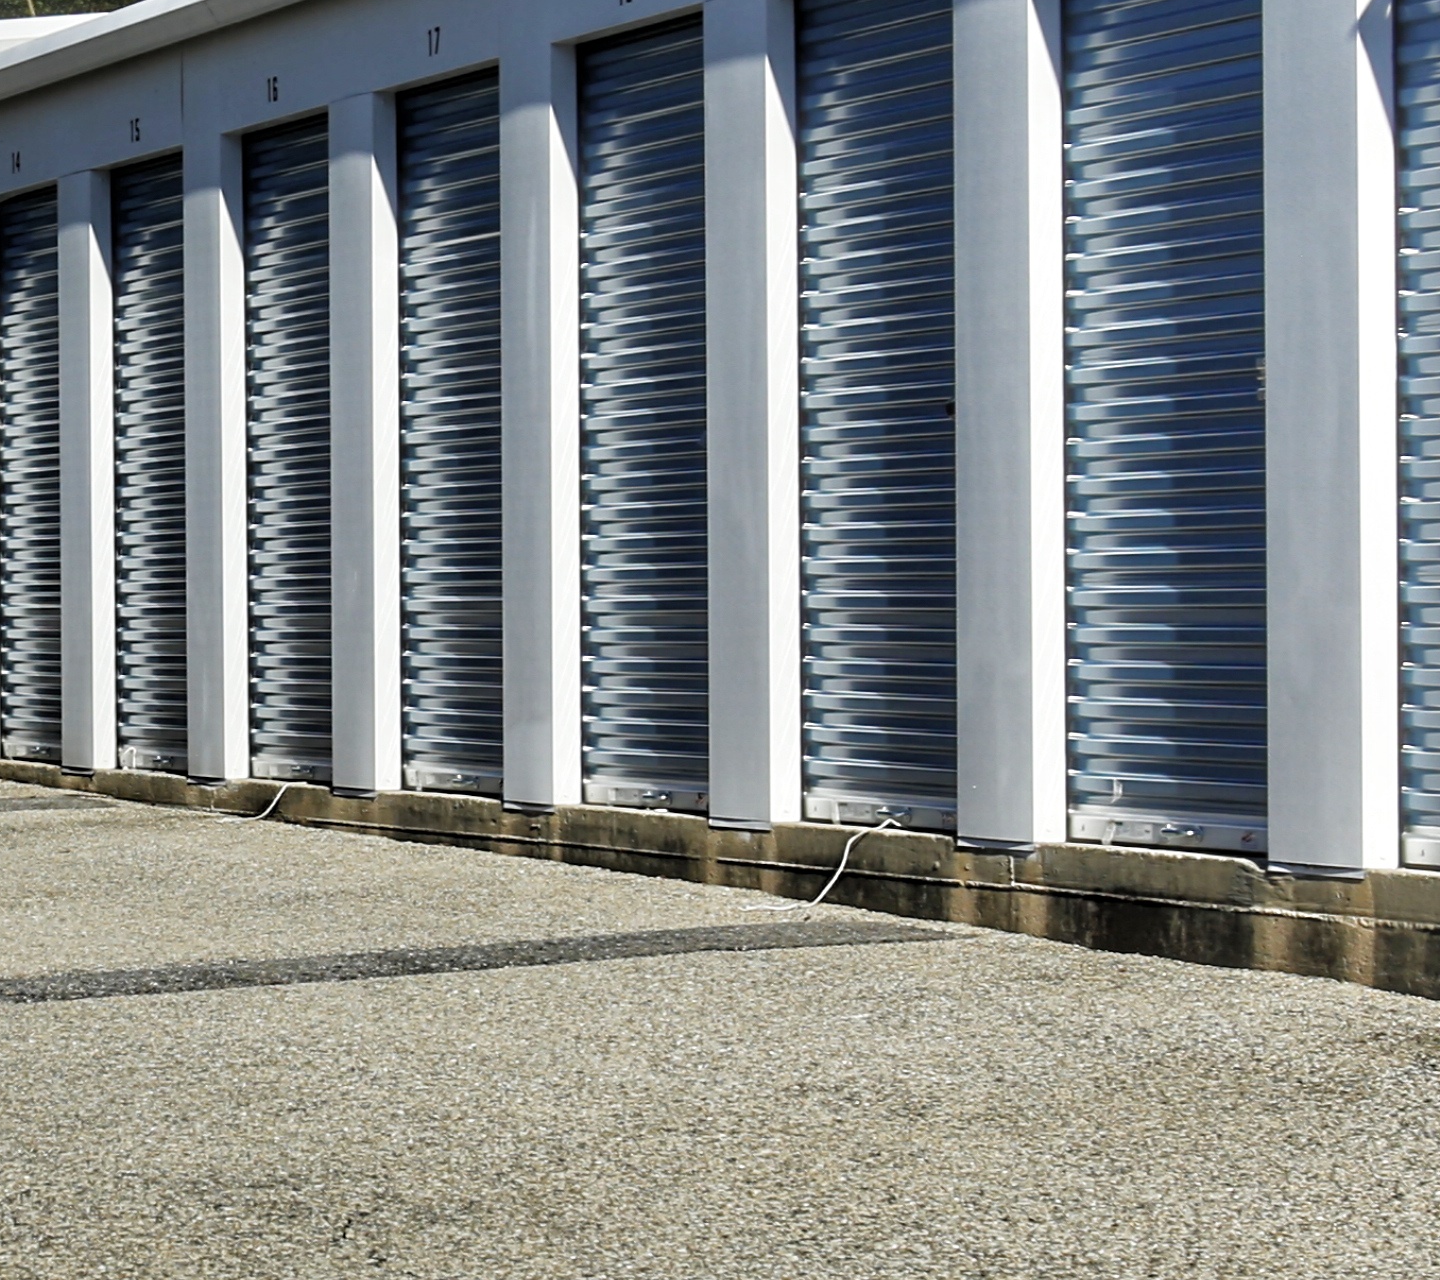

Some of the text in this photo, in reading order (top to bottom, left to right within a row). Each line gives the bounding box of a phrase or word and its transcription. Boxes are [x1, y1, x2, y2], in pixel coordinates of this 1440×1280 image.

[427, 25, 441, 57] 17
[266, 76, 279, 103] 16
[129, 117, 141, 143] 15
[11, 151, 22, 174] 14
